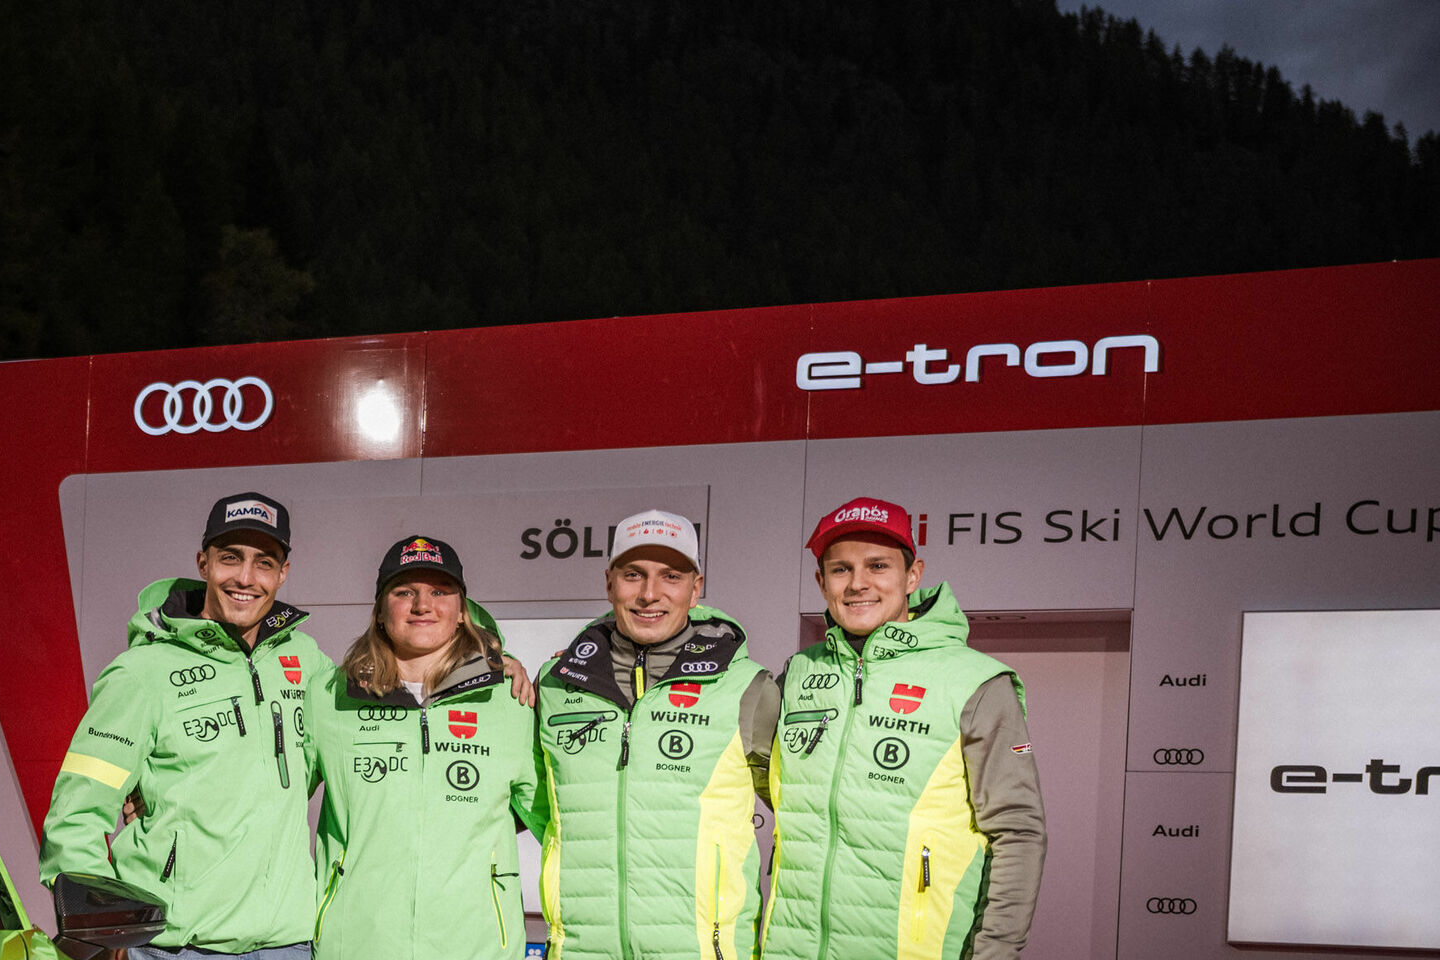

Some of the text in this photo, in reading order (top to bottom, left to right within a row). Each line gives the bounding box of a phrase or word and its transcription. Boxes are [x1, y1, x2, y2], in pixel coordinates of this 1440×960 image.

[796, 335, 1160, 391] e-tron
[227, 507, 270, 521] KAMPA
[948, 511, 1023, 546] FIS
[1044, 508, 1120, 543] Ski
[1143, 502, 1322, 542] World
[400, 552, 443, 565] Red Bull
[1159, 674, 1207, 687] Audi
[177, 688, 197, 699] Audi
[564, 697, 583, 705] Audi
[655, 763, 691, 773] BOGNER
[868, 772, 905, 785] BOGNER
[445, 794, 479, 804] BOGNER
[1152, 825, 1200, 838] Audi
